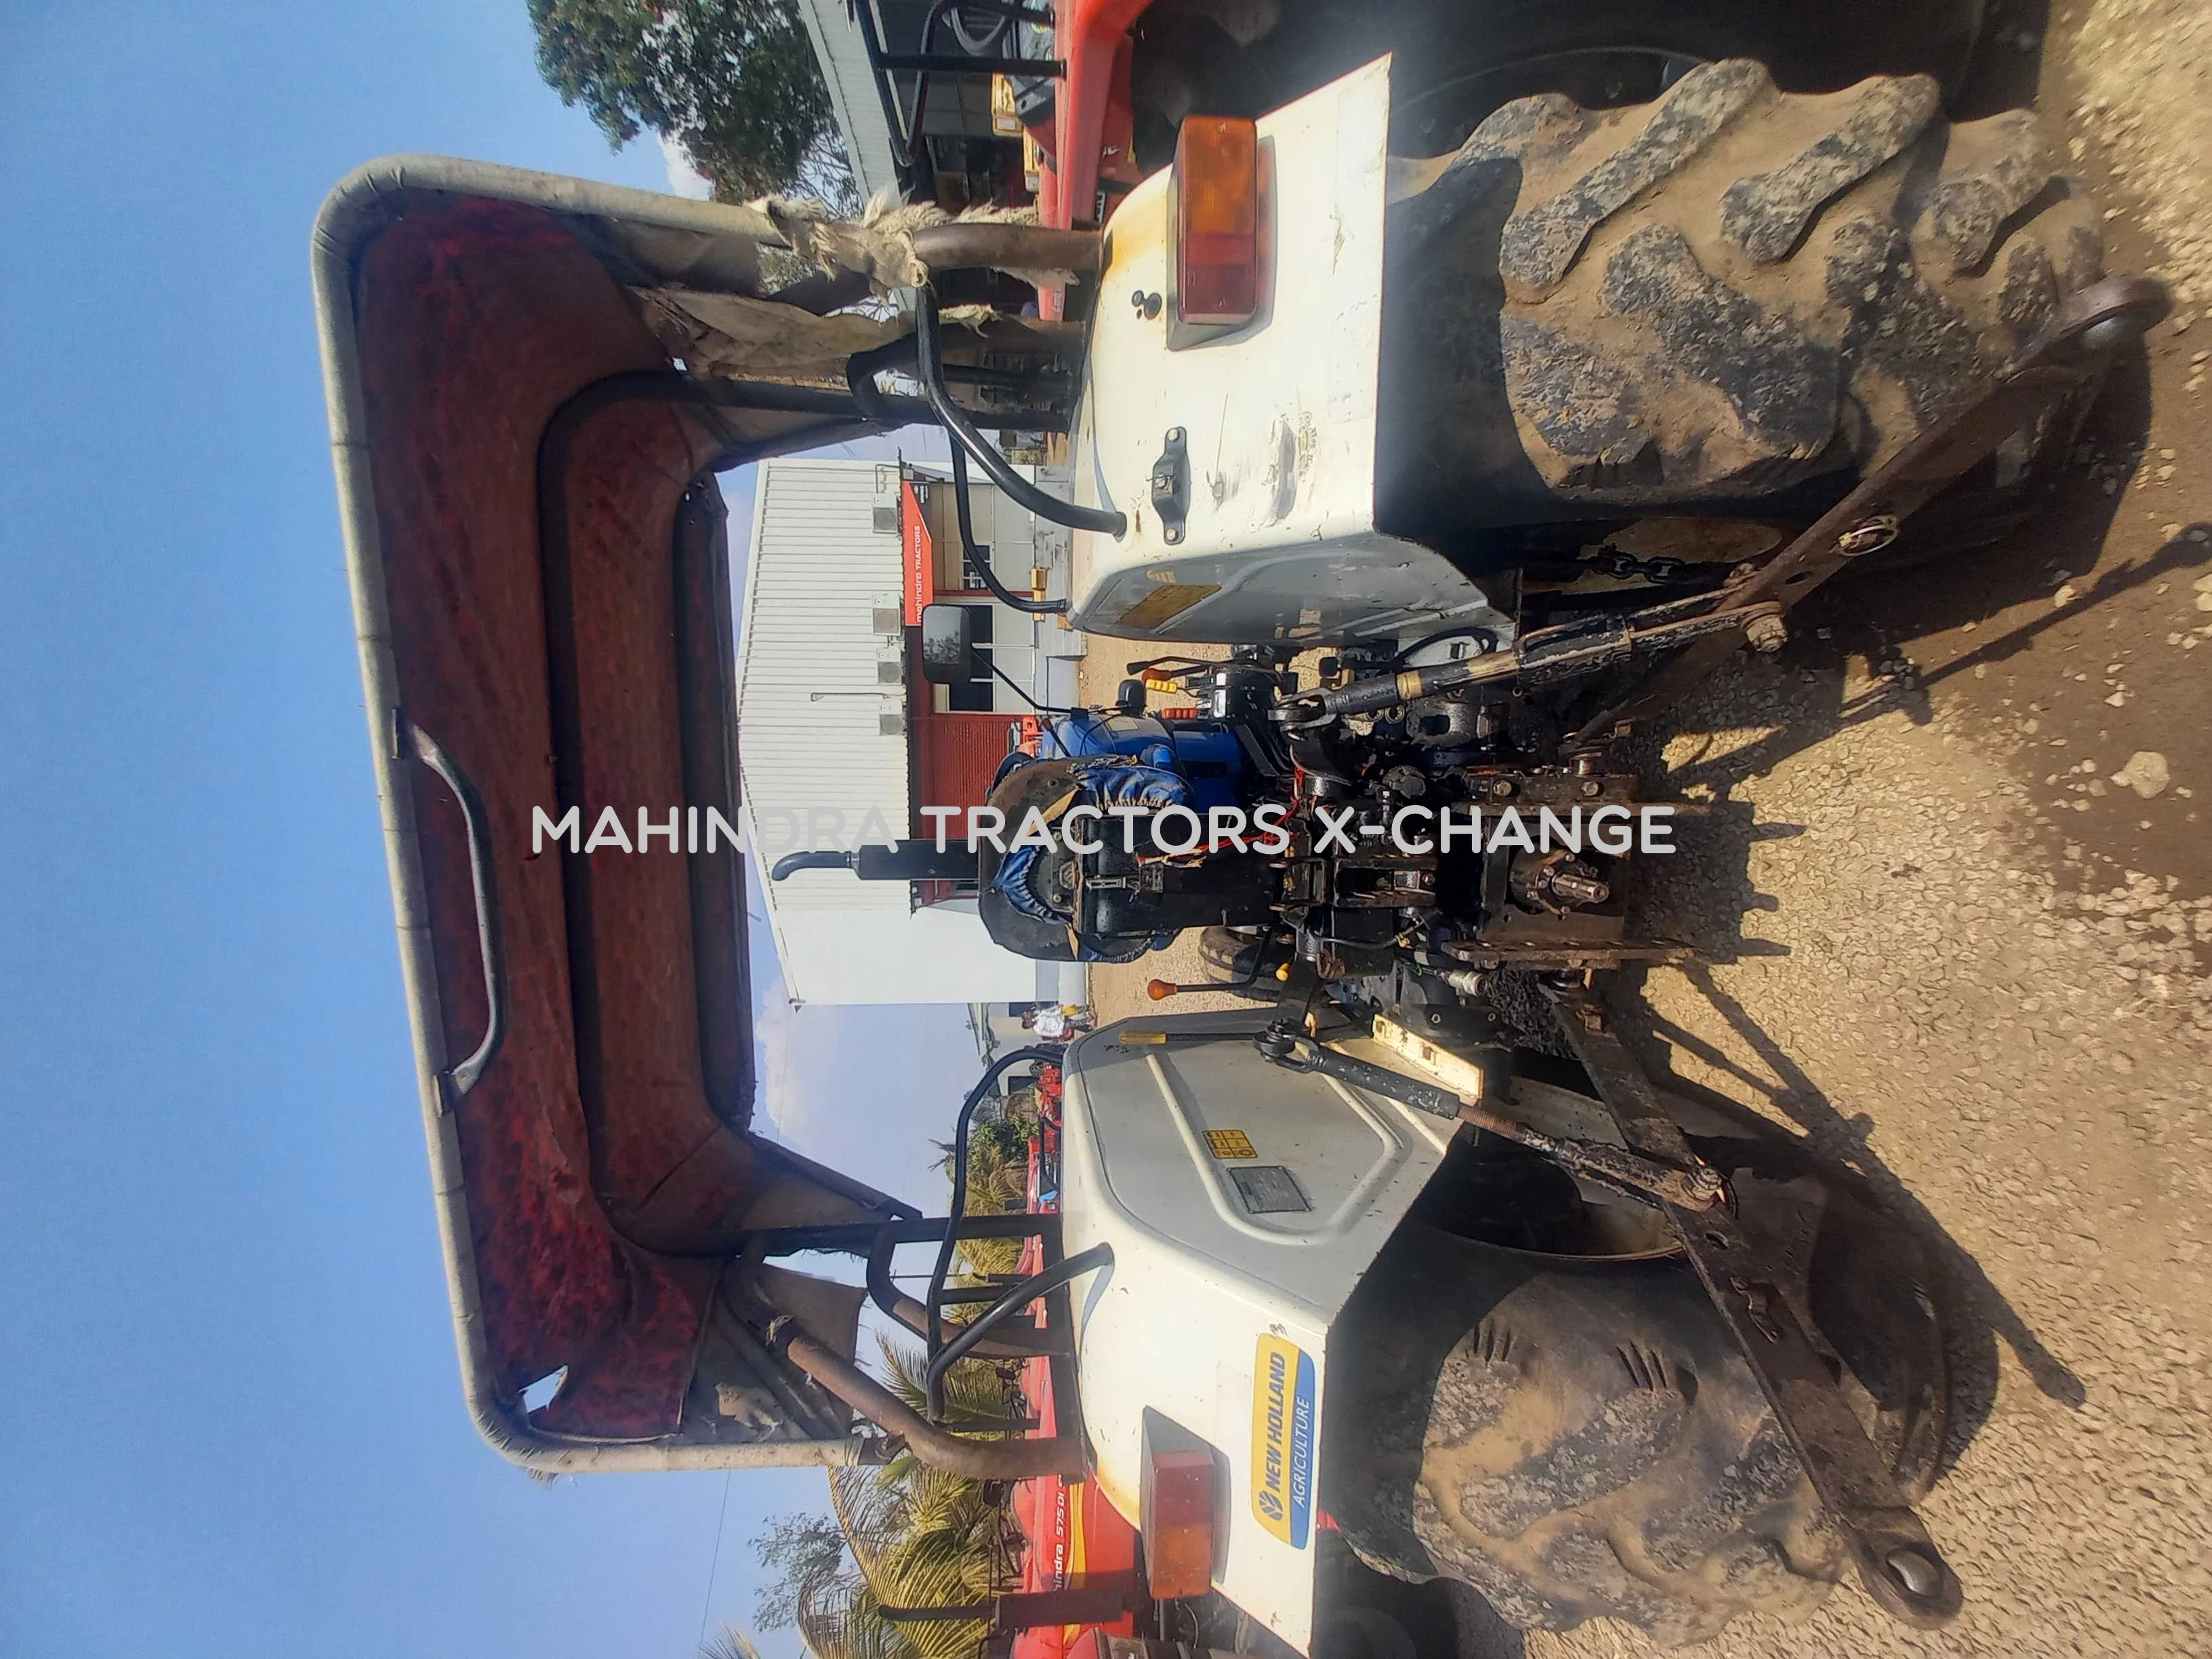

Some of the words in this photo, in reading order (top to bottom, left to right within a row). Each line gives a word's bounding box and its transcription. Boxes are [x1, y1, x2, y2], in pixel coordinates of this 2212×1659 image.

[1267, 1352, 1285, 1443] HOLLAND
[1266, 1444, 1280, 1491] NEW
[1293, 1397, 1309, 1507] AGRICULTURE
[1054, 1544, 1063, 1591] hindra
